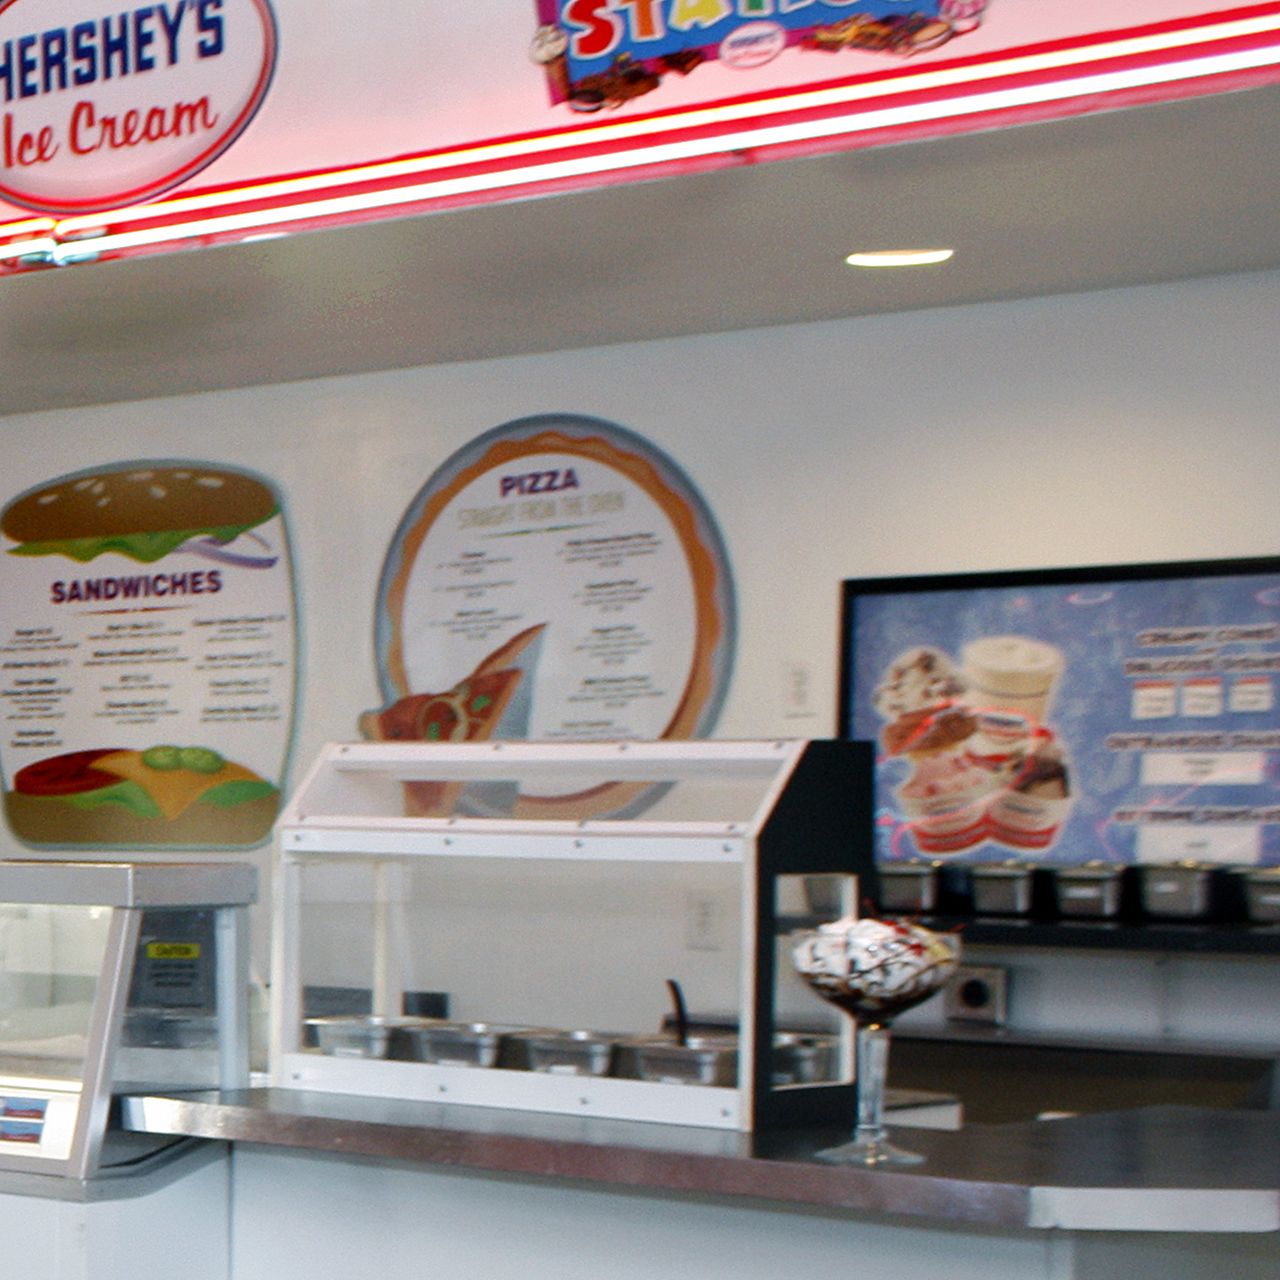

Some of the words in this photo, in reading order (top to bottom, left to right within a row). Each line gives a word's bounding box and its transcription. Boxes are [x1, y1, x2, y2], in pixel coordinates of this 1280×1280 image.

[2, 113, 60, 168] Ice
[69, 96, 218, 156] Cream
[499, 467, 580, 497] PIZZA
[50, 569, 223, 604] SANDWICHES
